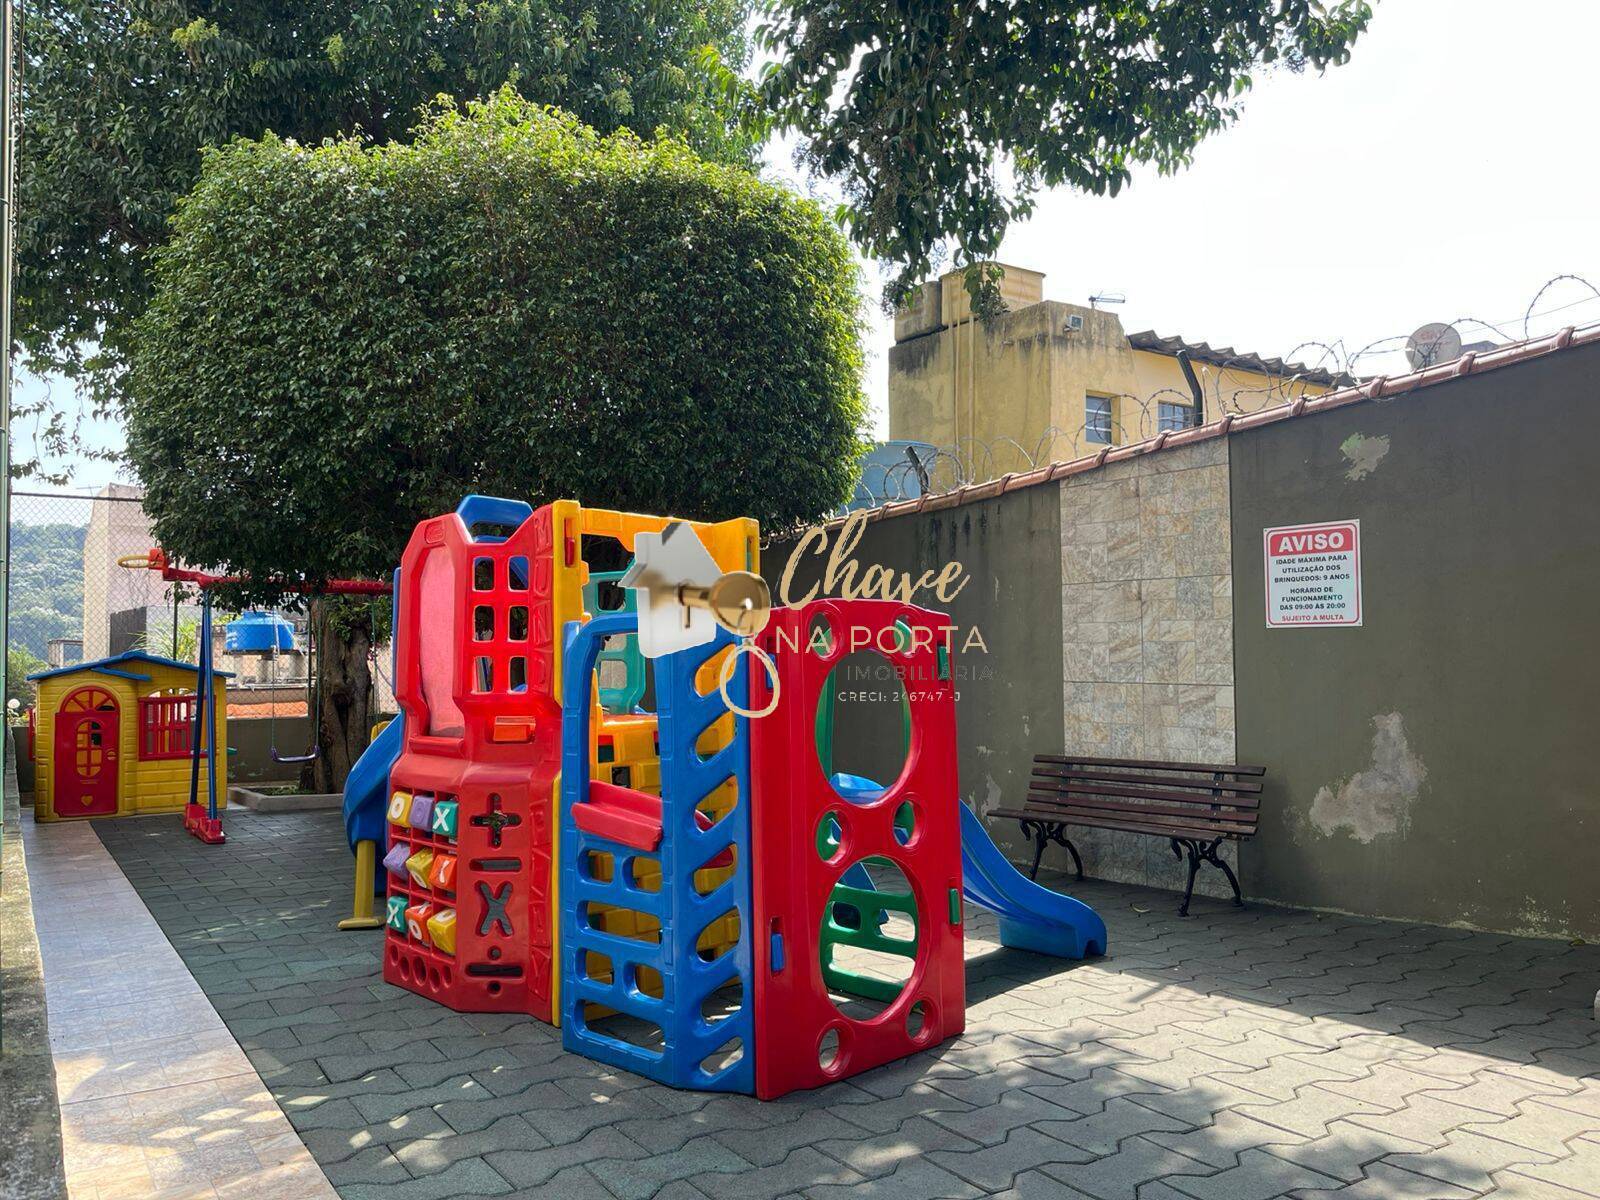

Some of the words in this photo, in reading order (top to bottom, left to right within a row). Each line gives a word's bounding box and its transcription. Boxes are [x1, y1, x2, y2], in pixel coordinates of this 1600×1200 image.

[1279, 532, 1344, 553] AVISO
[1276, 557, 1296, 565] IDADE
[1328, 554, 1347, 562] PARA
[1282, 565, 1324, 573] UTILIZAÇÃO
[1274, 575, 1322, 583] BRINQUEDOS:
[1281, 594, 1343, 602] FUNCIONAMENTO
[1281, 614, 1311, 622] SUJEITO
[1319, 613, 1344, 621] MULTA
